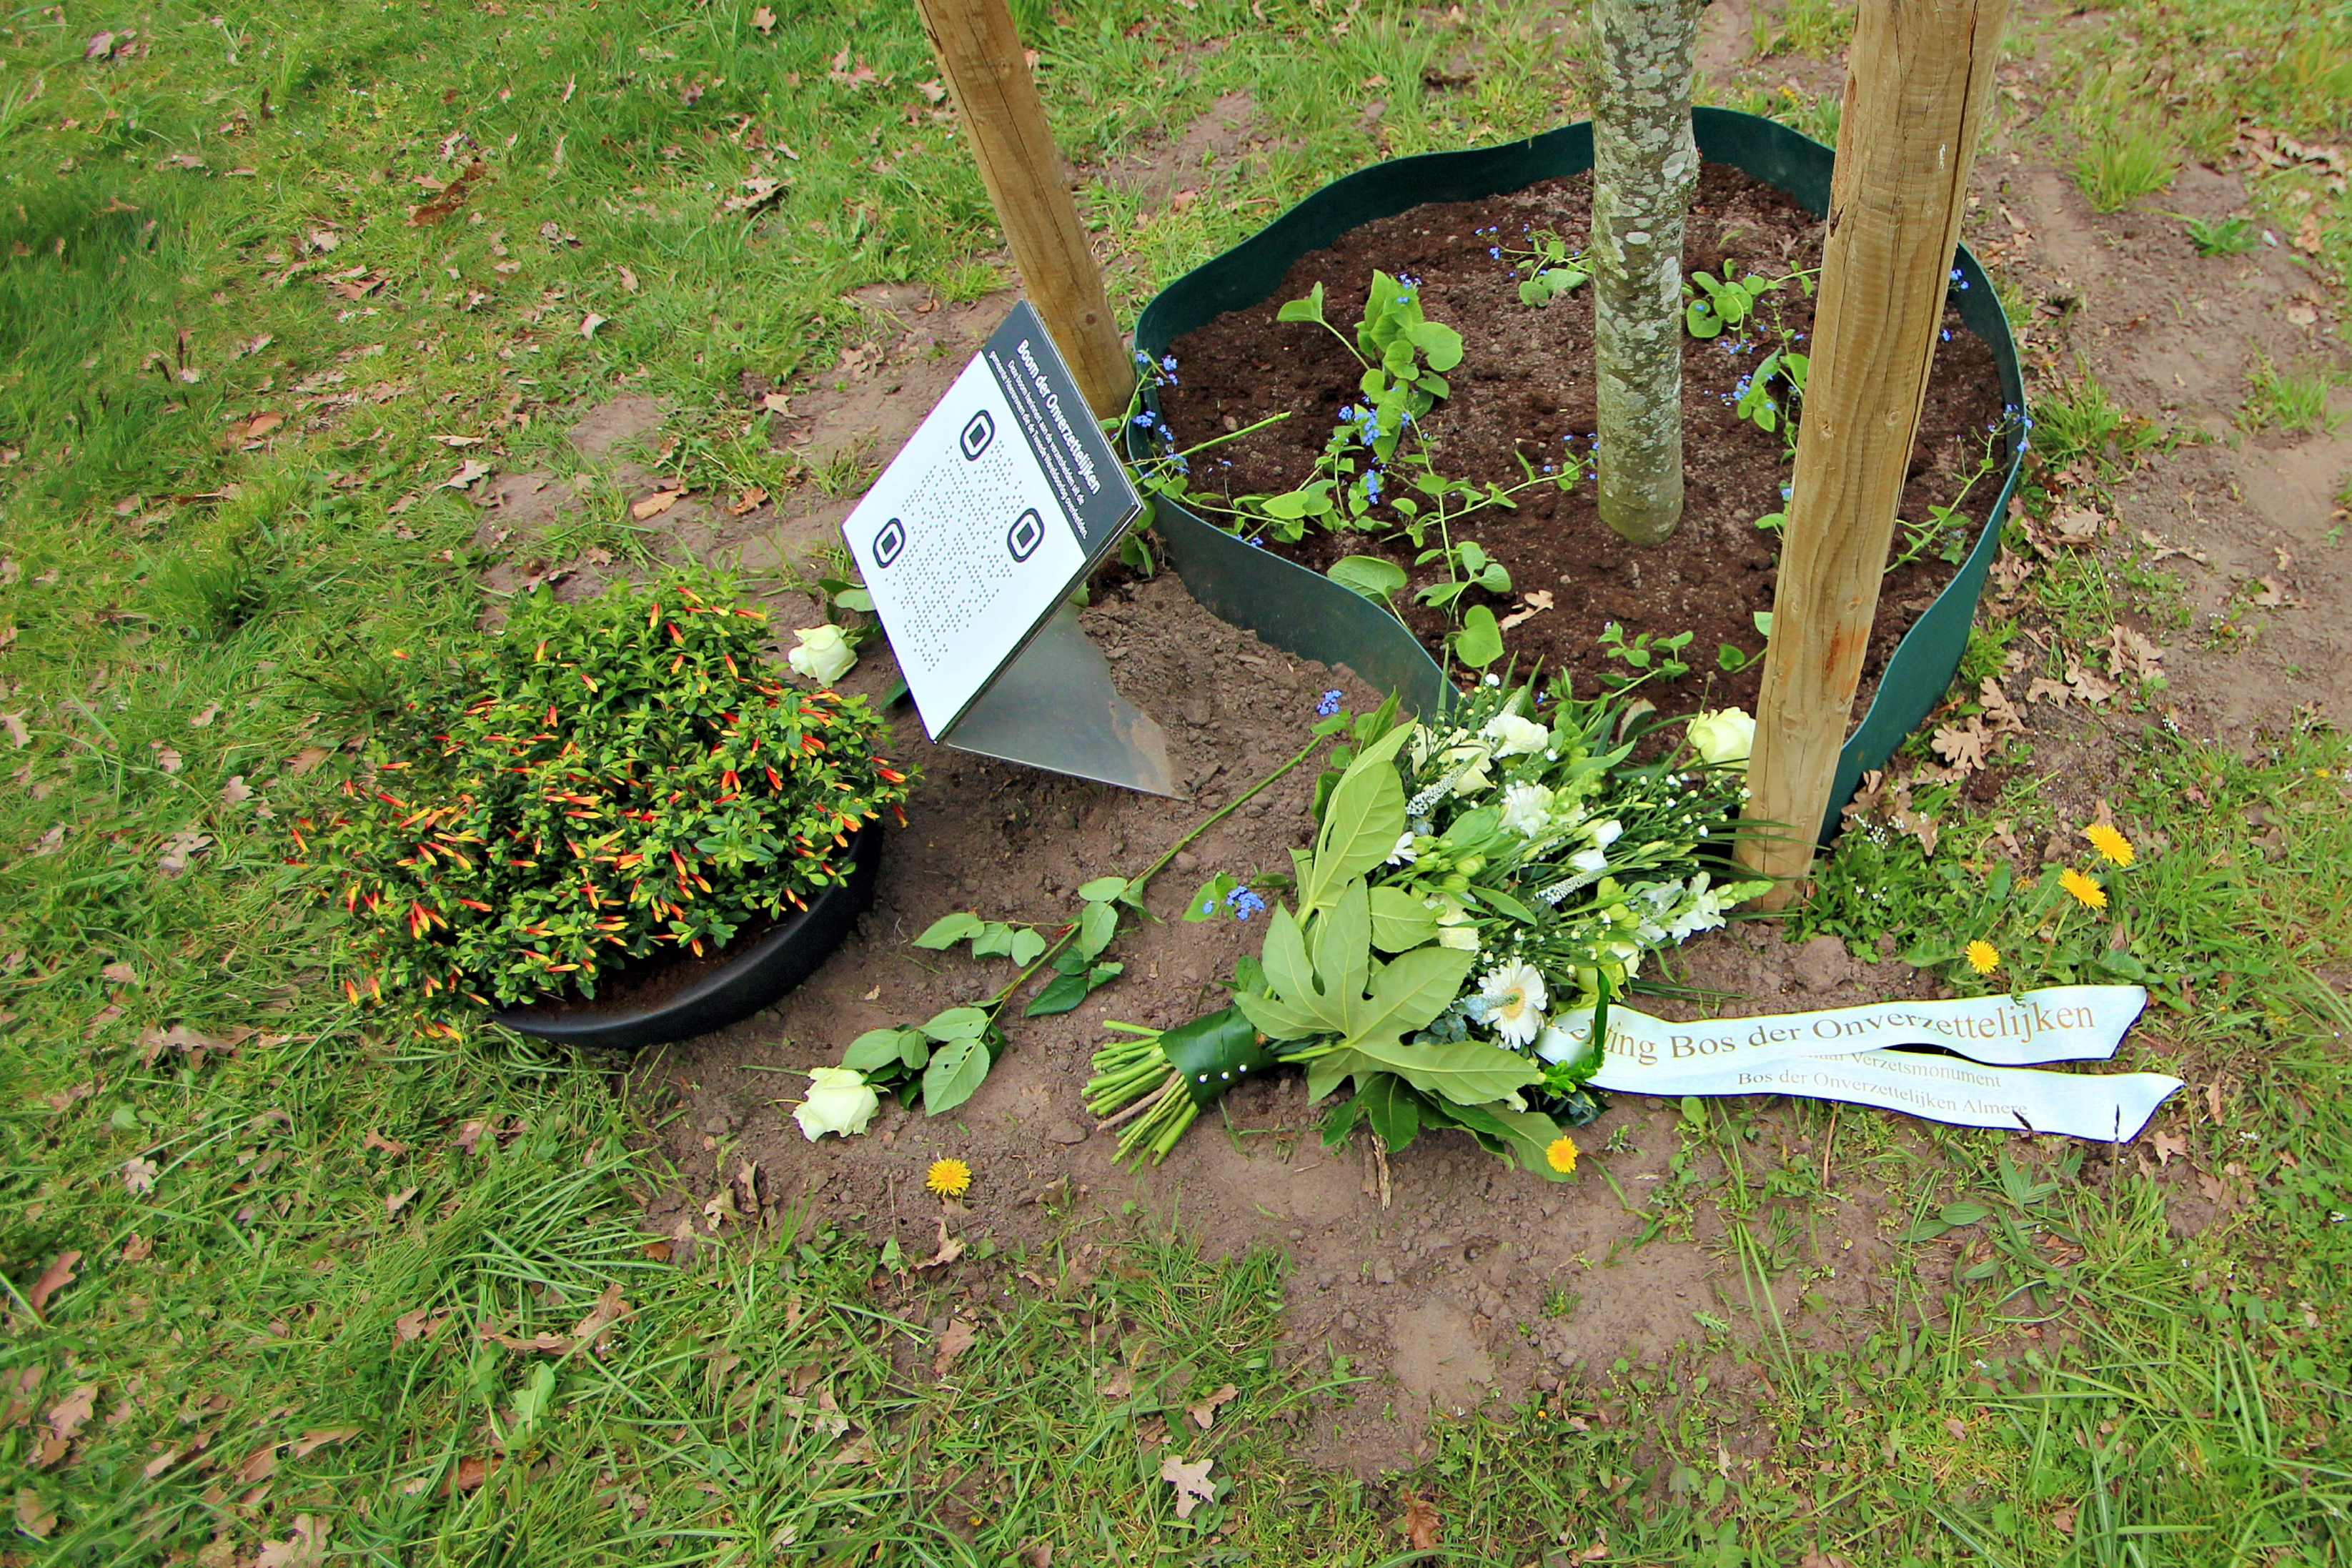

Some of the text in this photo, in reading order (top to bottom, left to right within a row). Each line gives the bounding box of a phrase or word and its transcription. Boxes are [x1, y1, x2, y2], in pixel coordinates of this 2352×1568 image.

[1007, 359, 1019, 379] Deze
[1015, 374, 1028, 397] boom
[1024, 391, 1043, 424] herinnert
[1017, 339, 1101, 495] Boom der Onverzettelijken
[1031, 430, 1047, 458] Tweede
[1669, 1035, 1736, 1058] Bos
[1747, 1025, 1802, 1047] der
[1812, 1001, 2096, 1043] Onverzettelijken
[1737, 1068, 2029, 1116] Bos der Onverzettelijken Almere
[1851, 1051, 2002, 1088] Verzetsmonument
